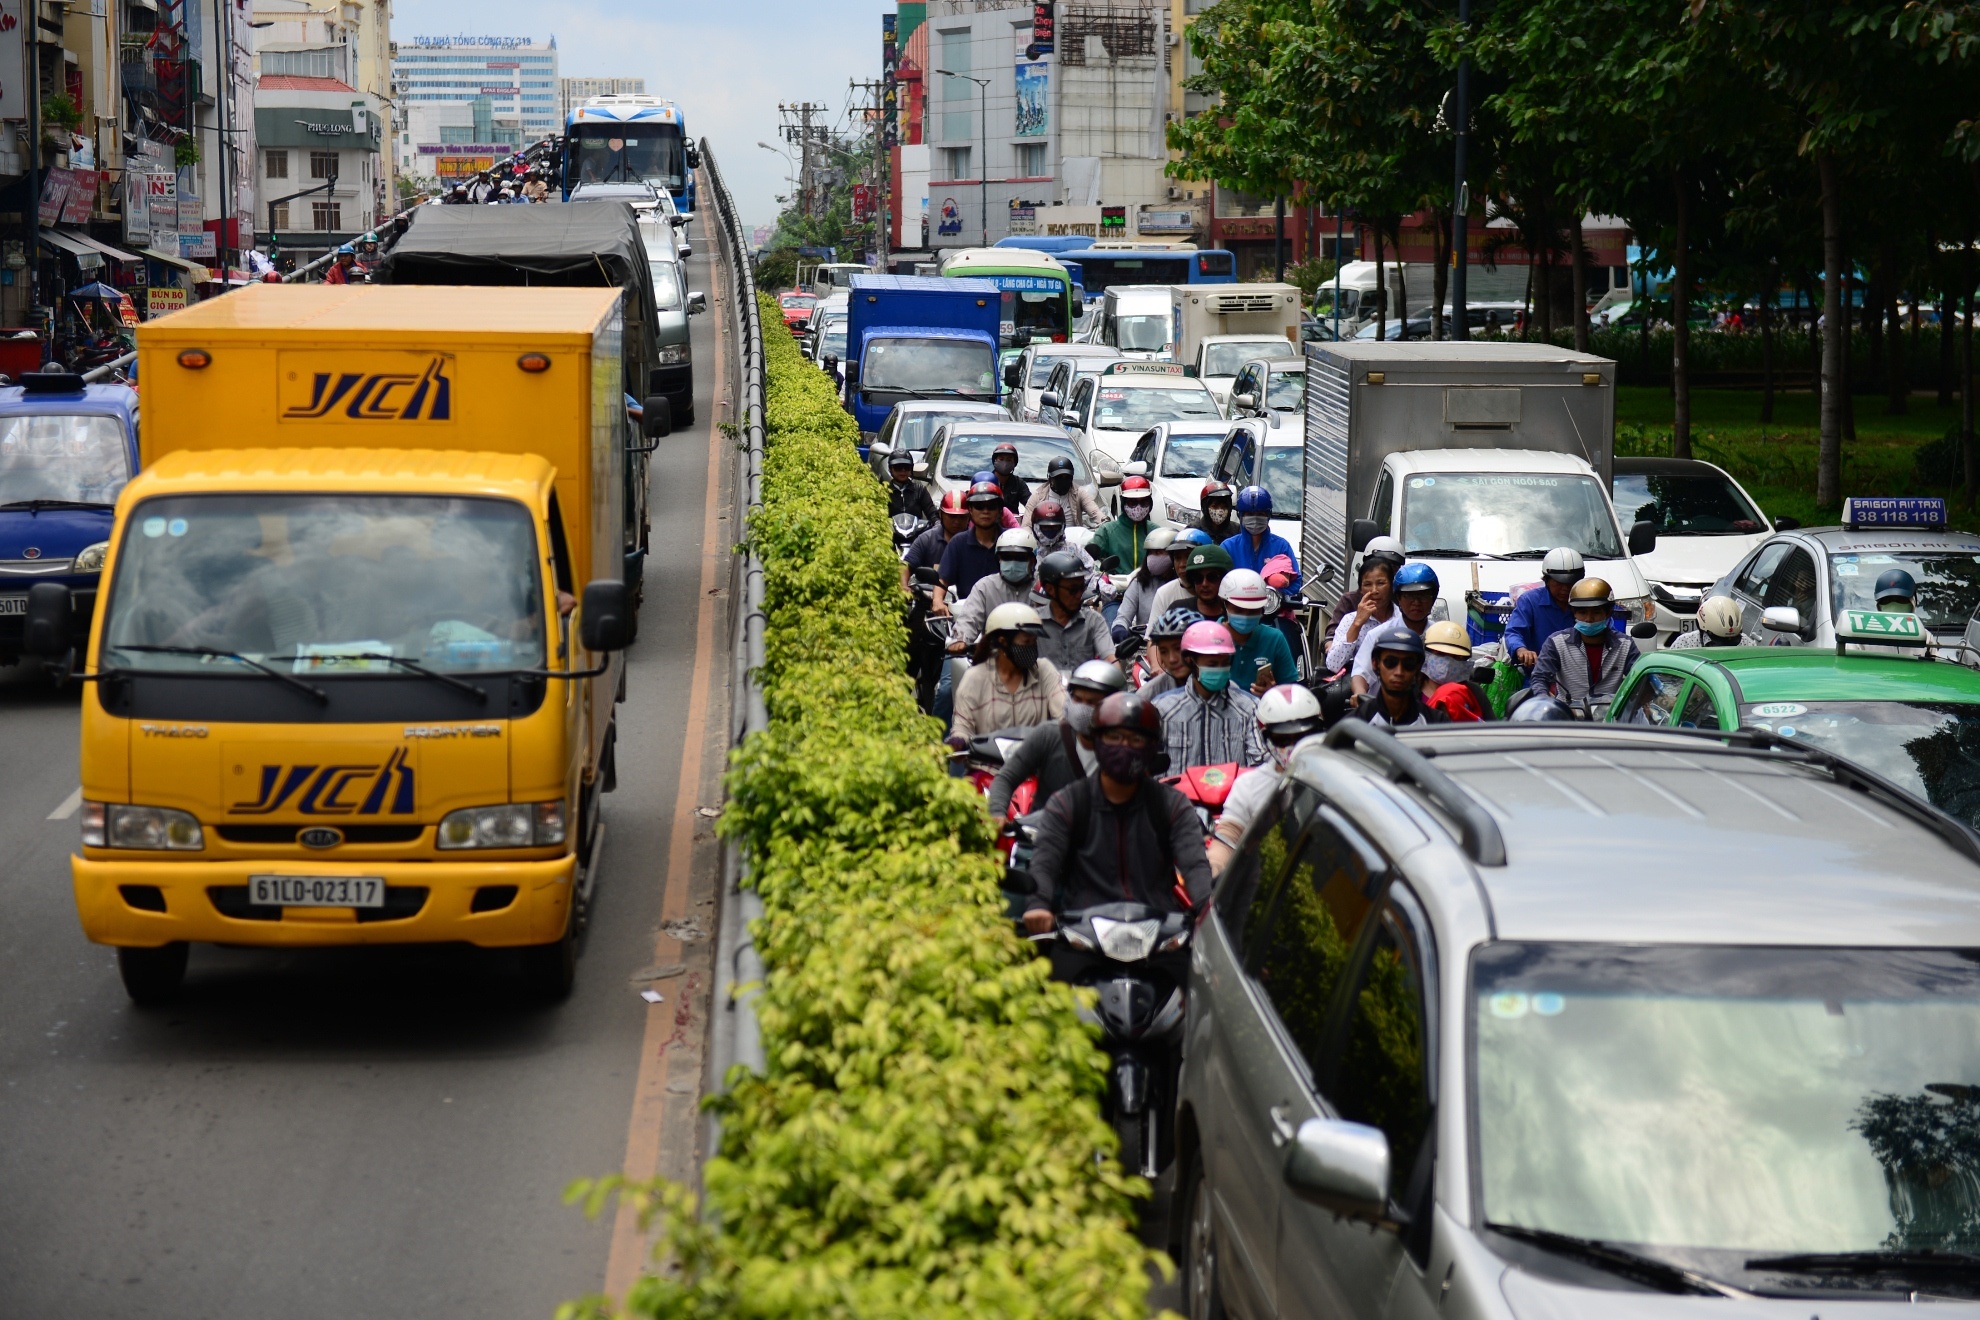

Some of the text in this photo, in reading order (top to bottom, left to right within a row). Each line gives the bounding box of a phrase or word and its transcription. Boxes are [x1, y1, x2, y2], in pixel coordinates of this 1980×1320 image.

[1035, 5, 1045, 14] Xe
[413, 34, 431, 45] TÒA
[432, 34, 450, 46] NHÀ
[453, 32, 475, 46] TỔNG
[330, 124, 352, 132] LONG
[147, 182, 165, 195] IN
[151, 288, 170, 298] BÚN
[172, 289, 183, 299] BÒ
[150, 301, 165, 310] GIÒ
[1000, 323, 1014, 333] 59
[1131, 364, 1182, 374] VINASUN TAXI
[1472, 476, 1558, 487] SÀI GÒN NGÔI SAO
[1918, 501, 1941, 509] TAXI
[1857, 511, 1939, 522] 38 118 118
[1839, 542, 1916, 551] SAIGON
[1763, 705, 1796, 714] 6522
[141, 725, 209, 738] THACO
[403, 725, 502, 739] FRONTIER
[304, 832, 335, 844] KIA
